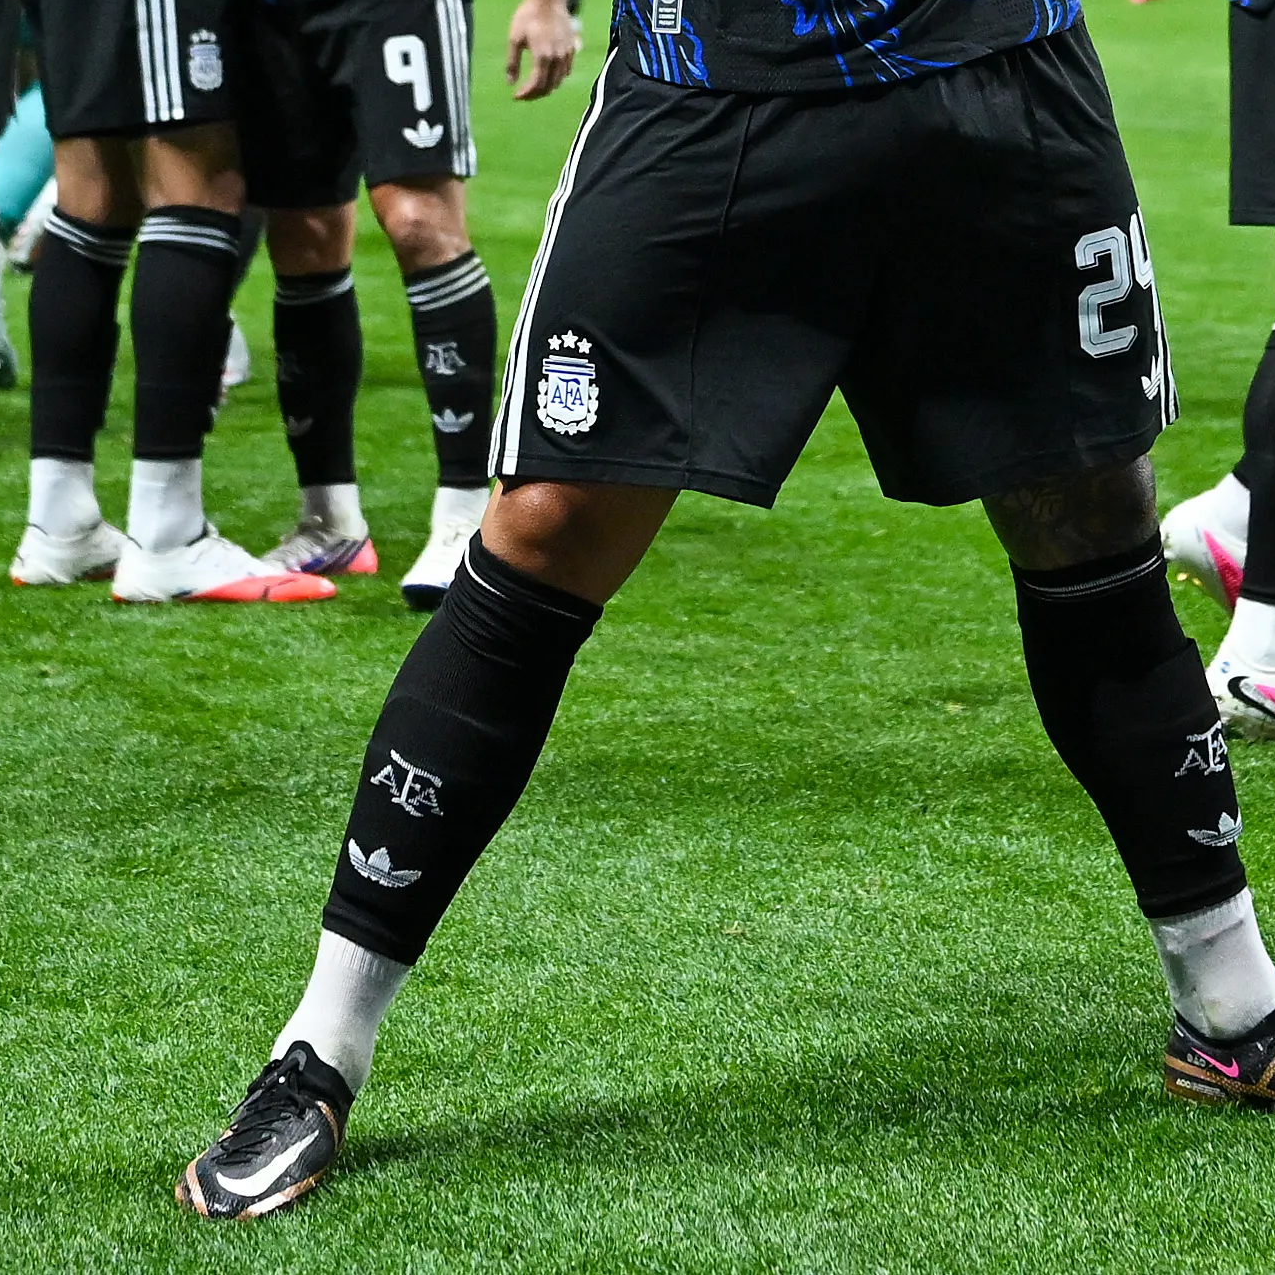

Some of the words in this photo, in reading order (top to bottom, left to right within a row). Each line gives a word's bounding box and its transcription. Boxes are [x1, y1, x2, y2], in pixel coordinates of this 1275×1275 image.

[382, 34, 433, 113] 9
[551, 376, 584, 412] AFA
[1174, 719, 1228, 778] AFA
[370, 748, 444, 818] AFA
